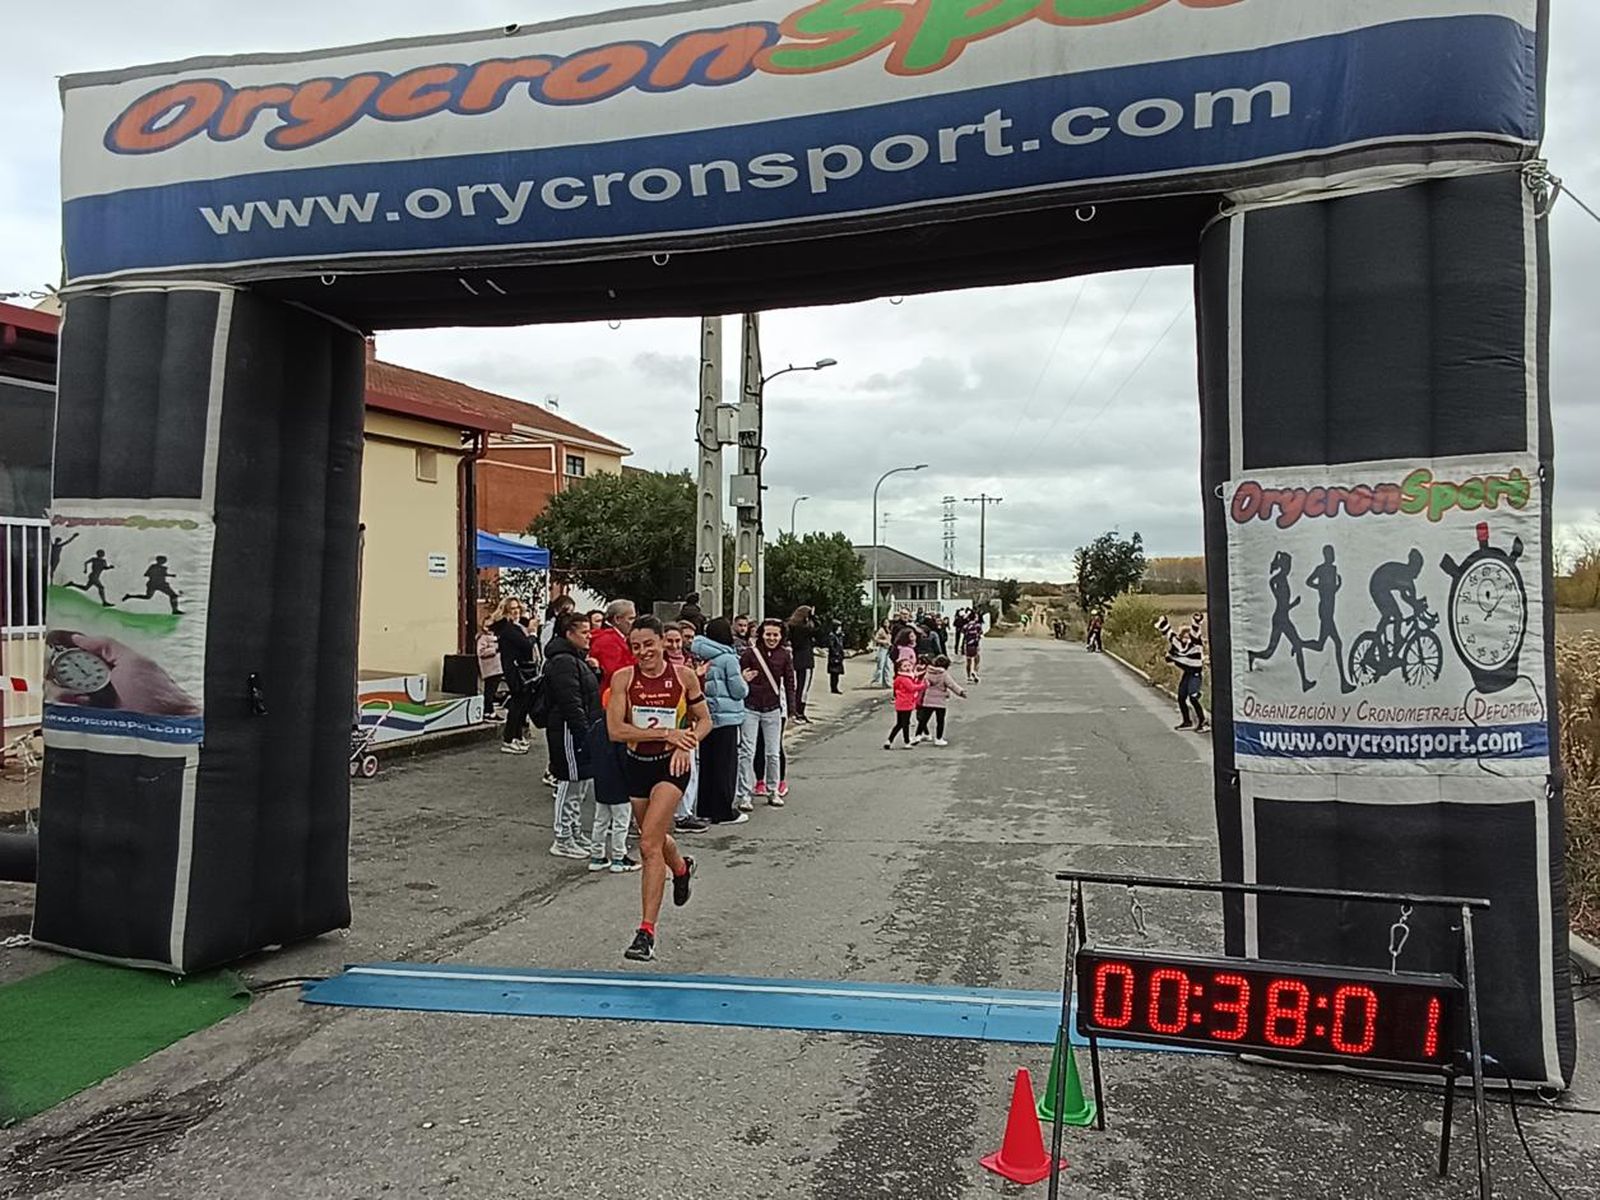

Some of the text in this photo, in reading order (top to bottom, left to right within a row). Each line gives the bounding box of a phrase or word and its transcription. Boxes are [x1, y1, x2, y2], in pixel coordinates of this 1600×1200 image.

[200, 79, 1293, 237] www.orycronsport.com
[1231, 467, 1531, 529] OrycronSport
[419, 678, 424, 691] 1
[475, 706, 482, 720] 3
[647, 716, 659, 729] 2
[1258, 728, 1523, 757] www.orycronsport.com
[1093, 962, 1441, 1058] 00:38:01
